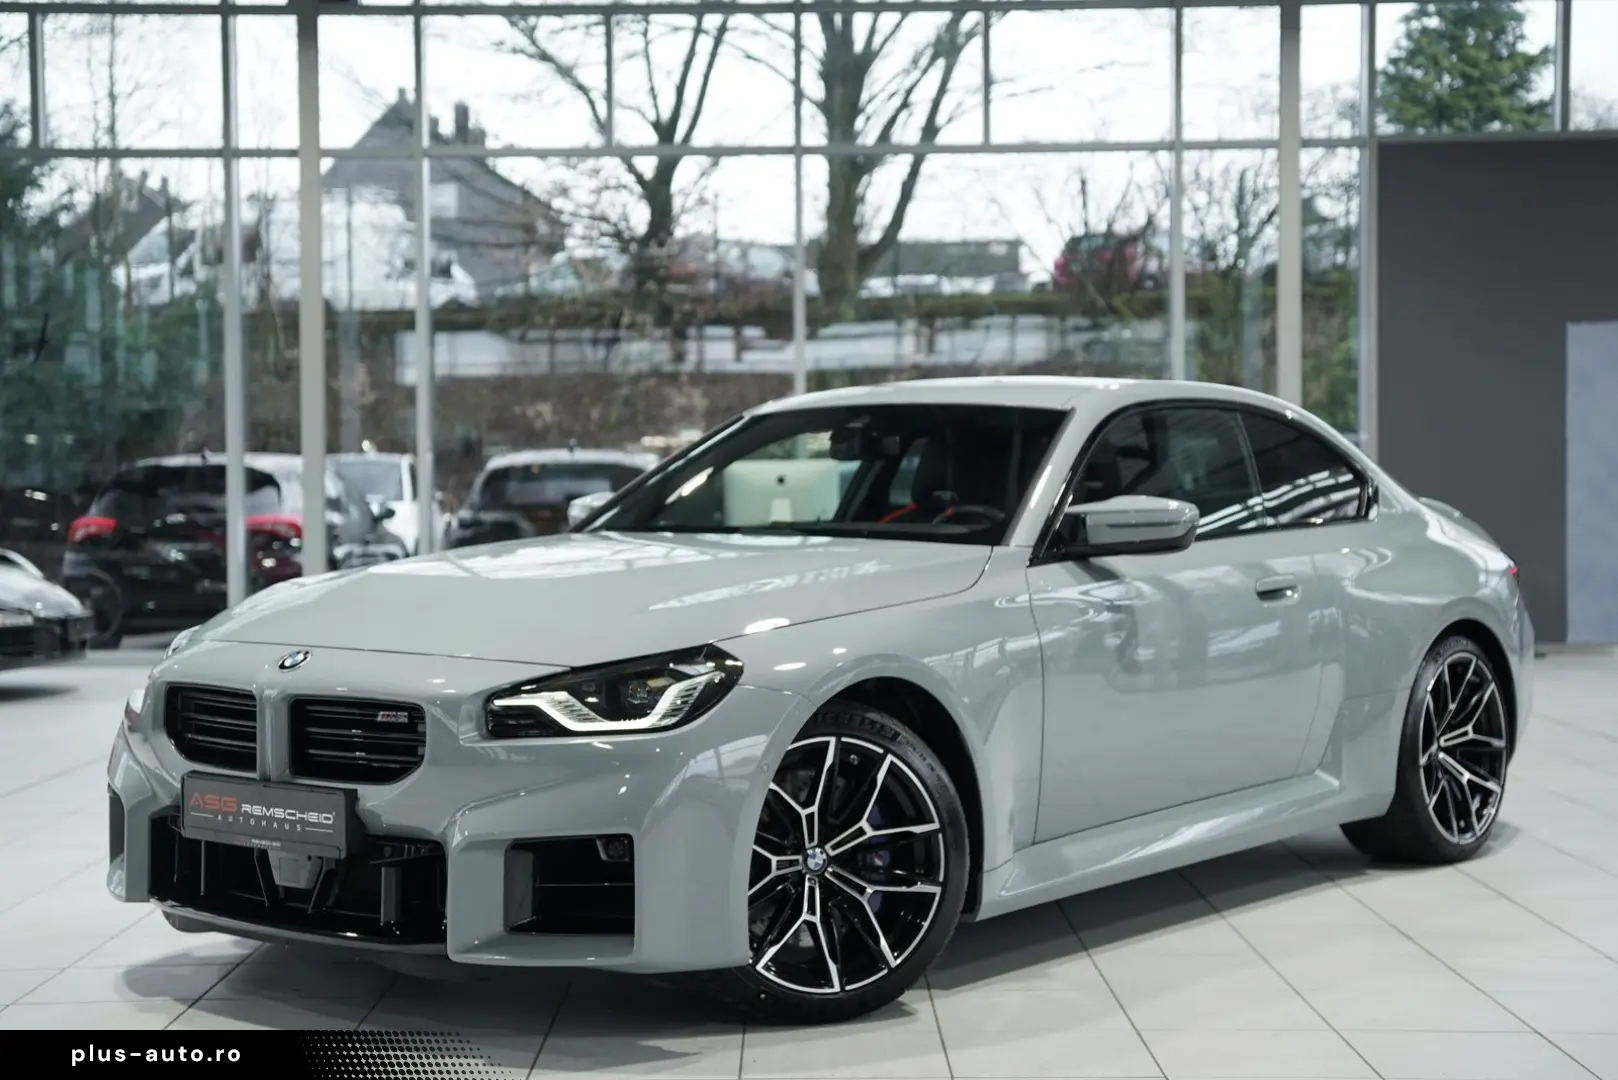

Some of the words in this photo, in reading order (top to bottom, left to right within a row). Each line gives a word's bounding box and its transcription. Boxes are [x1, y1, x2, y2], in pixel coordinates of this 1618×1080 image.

[189, 792, 237, 813] ASG
[241, 803, 334, 825] REMSCHEID
[217, 814, 301, 832] AUTOHAUS
